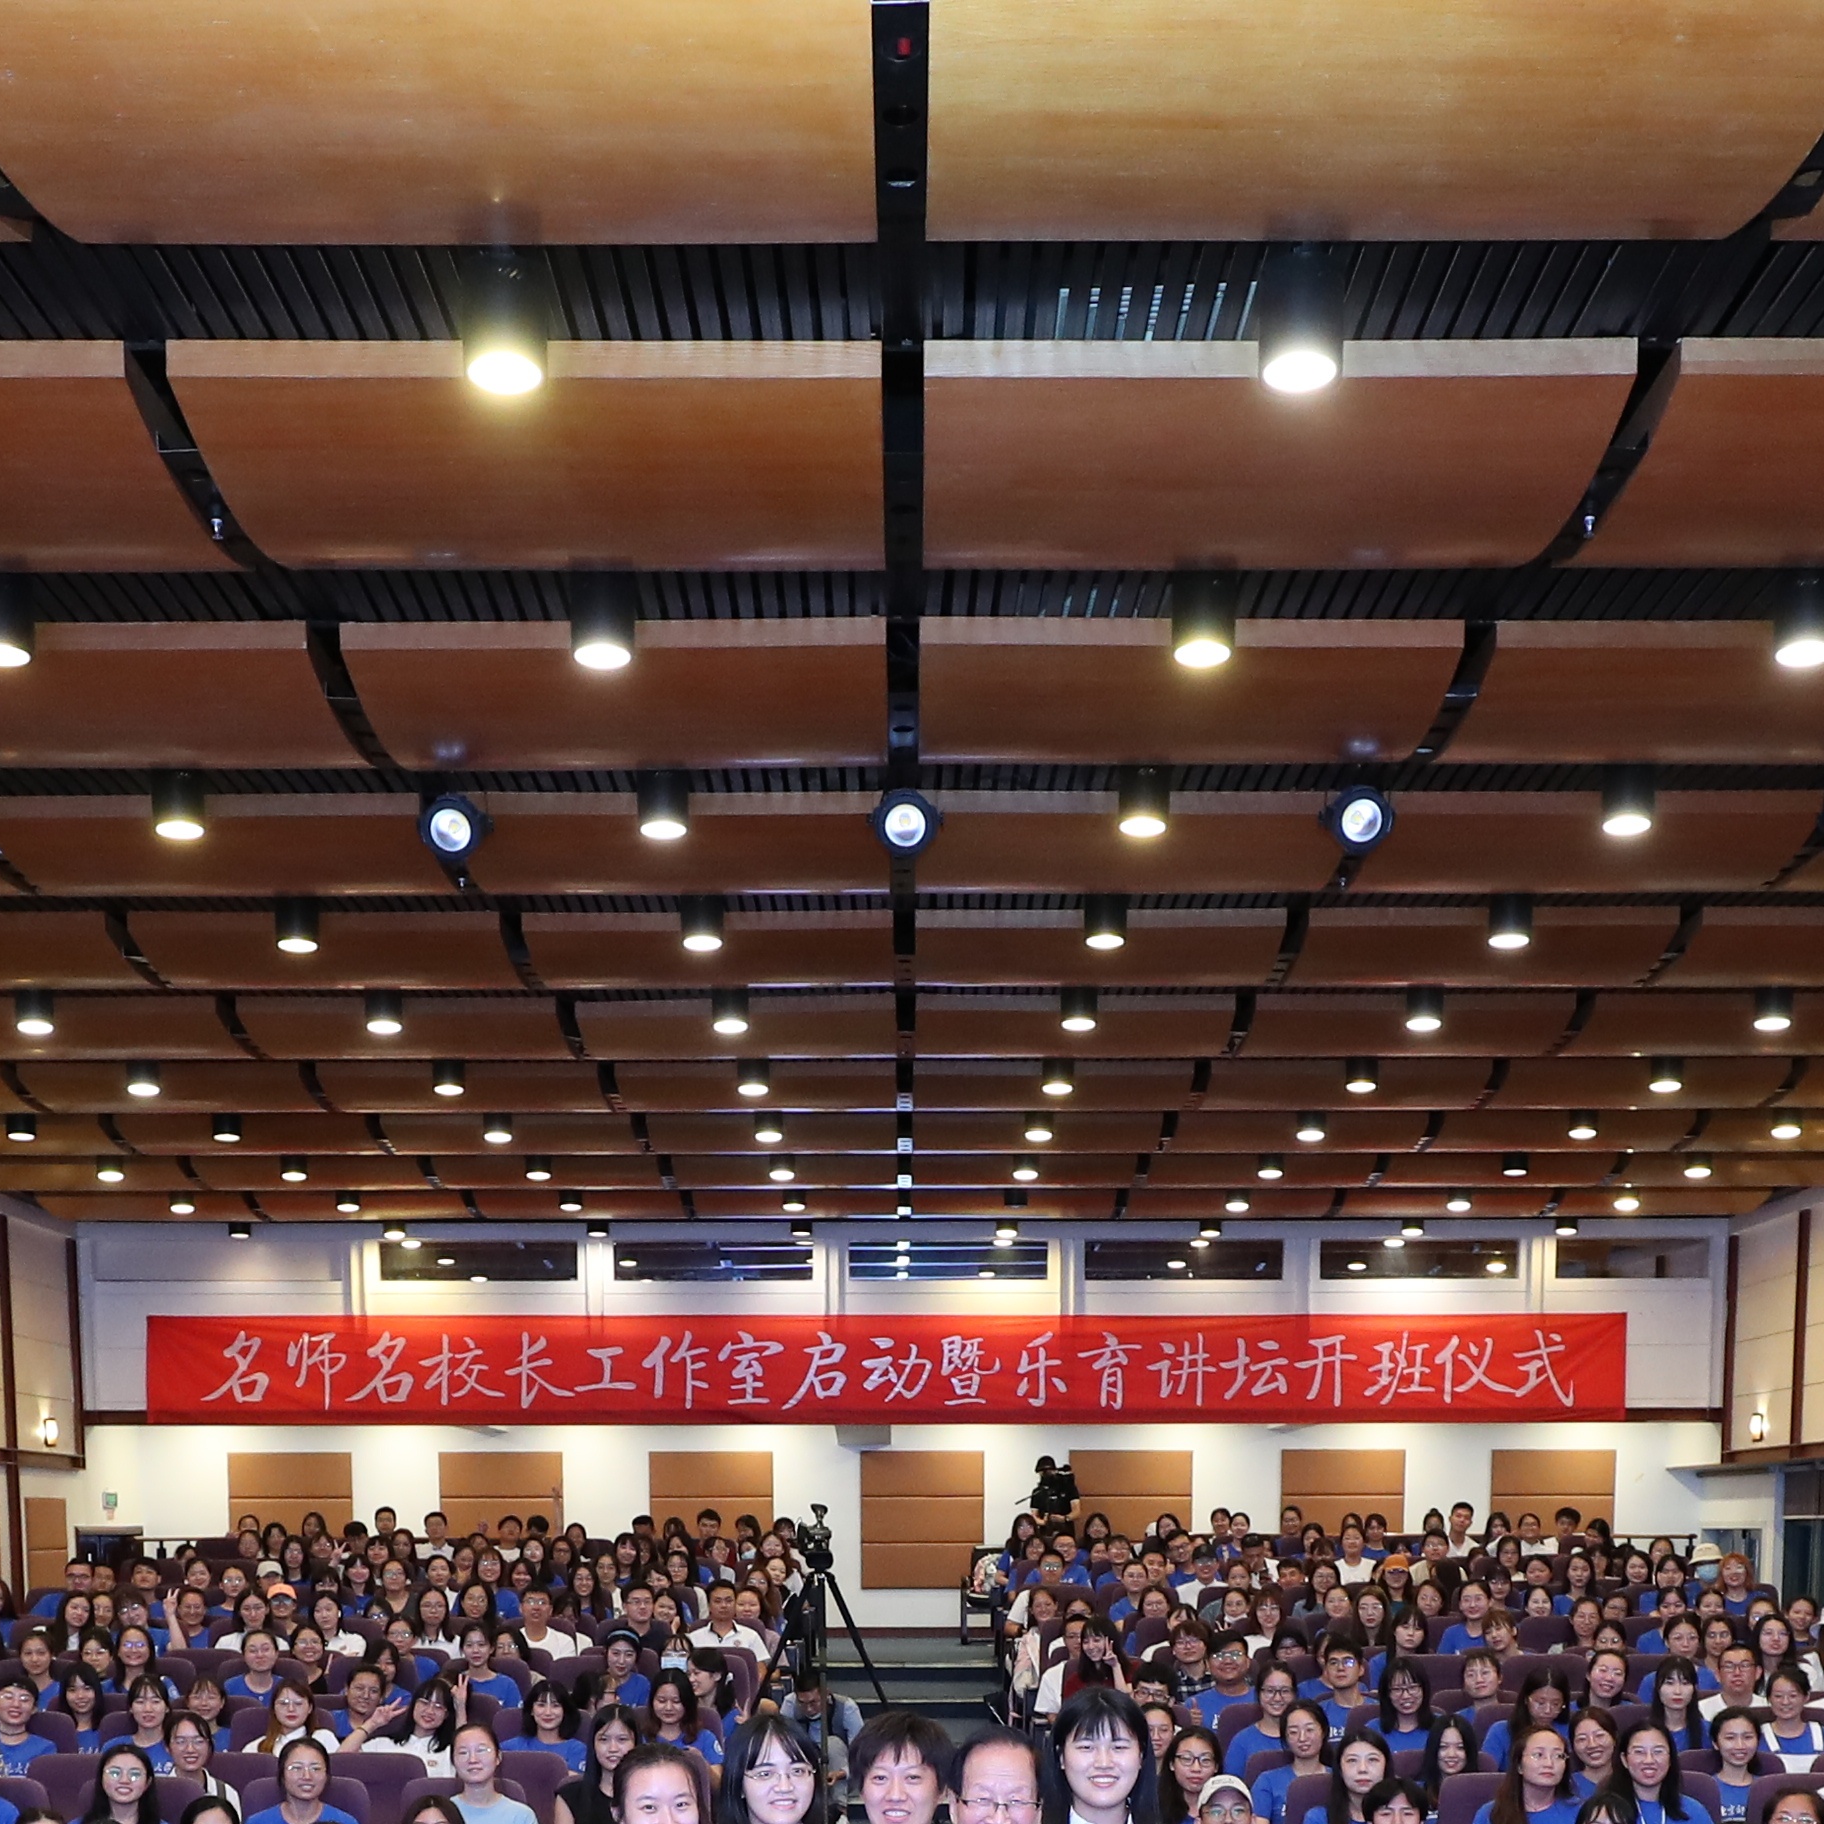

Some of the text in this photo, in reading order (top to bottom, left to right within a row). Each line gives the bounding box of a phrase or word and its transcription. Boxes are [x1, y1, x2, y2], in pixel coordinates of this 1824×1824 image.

[204, 1329, 1575, 1410] 名师名校长工作室启动暨乐育讲坛开班仪式
